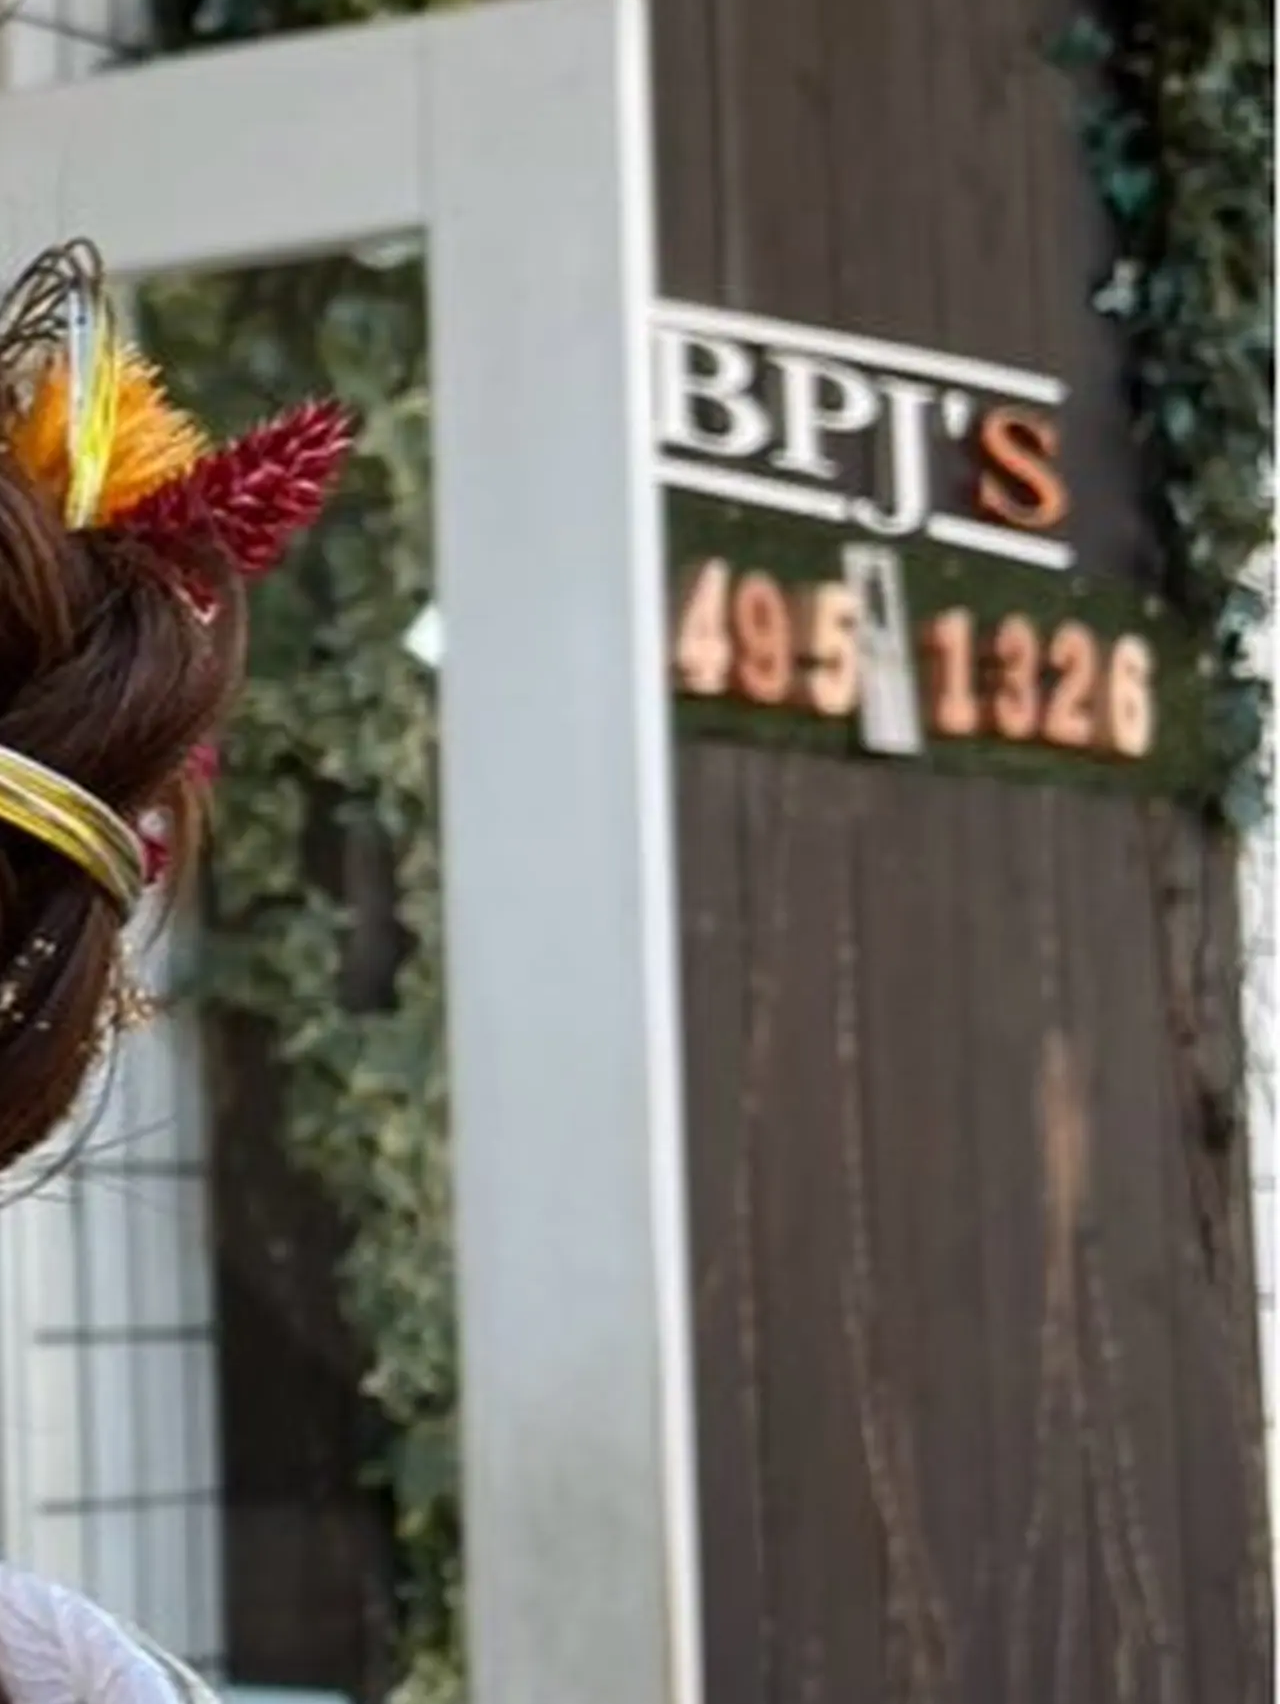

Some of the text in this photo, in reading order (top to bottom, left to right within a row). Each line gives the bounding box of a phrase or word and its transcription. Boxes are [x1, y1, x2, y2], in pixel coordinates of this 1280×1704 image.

[652, 329, 1070, 536] BPJ'S
[676, 557, 1153, 758] 495 1326
